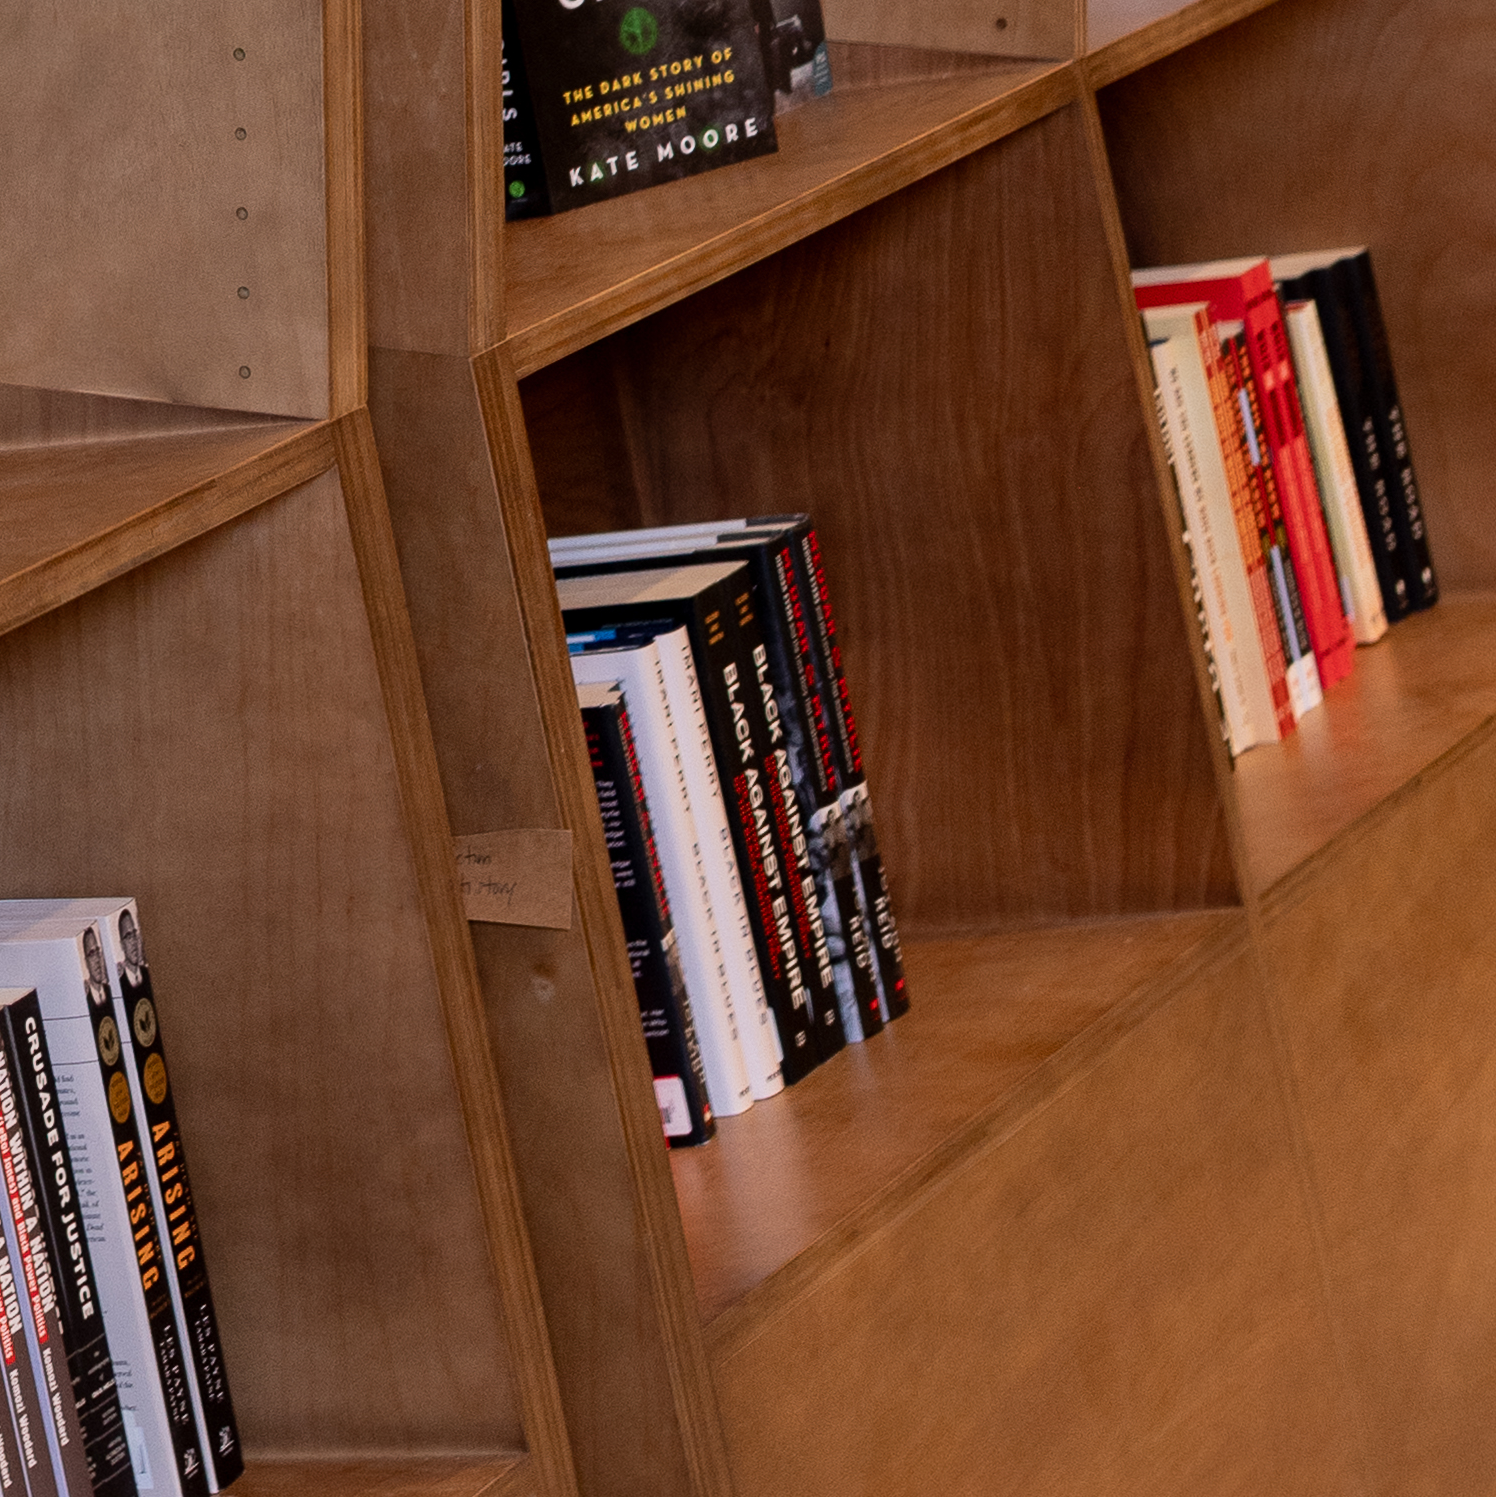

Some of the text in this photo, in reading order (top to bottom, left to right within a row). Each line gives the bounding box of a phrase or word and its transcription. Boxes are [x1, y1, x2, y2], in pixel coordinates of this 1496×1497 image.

[563, 47, 733, 105] THE DARK STORY OF
[624, 106, 687, 133] WOMEN
[569, 117, 759, 187] KATE MOORE
[722, 661, 807, 1011] BLACK AGAINST EMPIRE
[24, 1016, 96, 1321] CRUSADE FOR JUSTICE
[116, 1138, 158, 1293] ARISING
